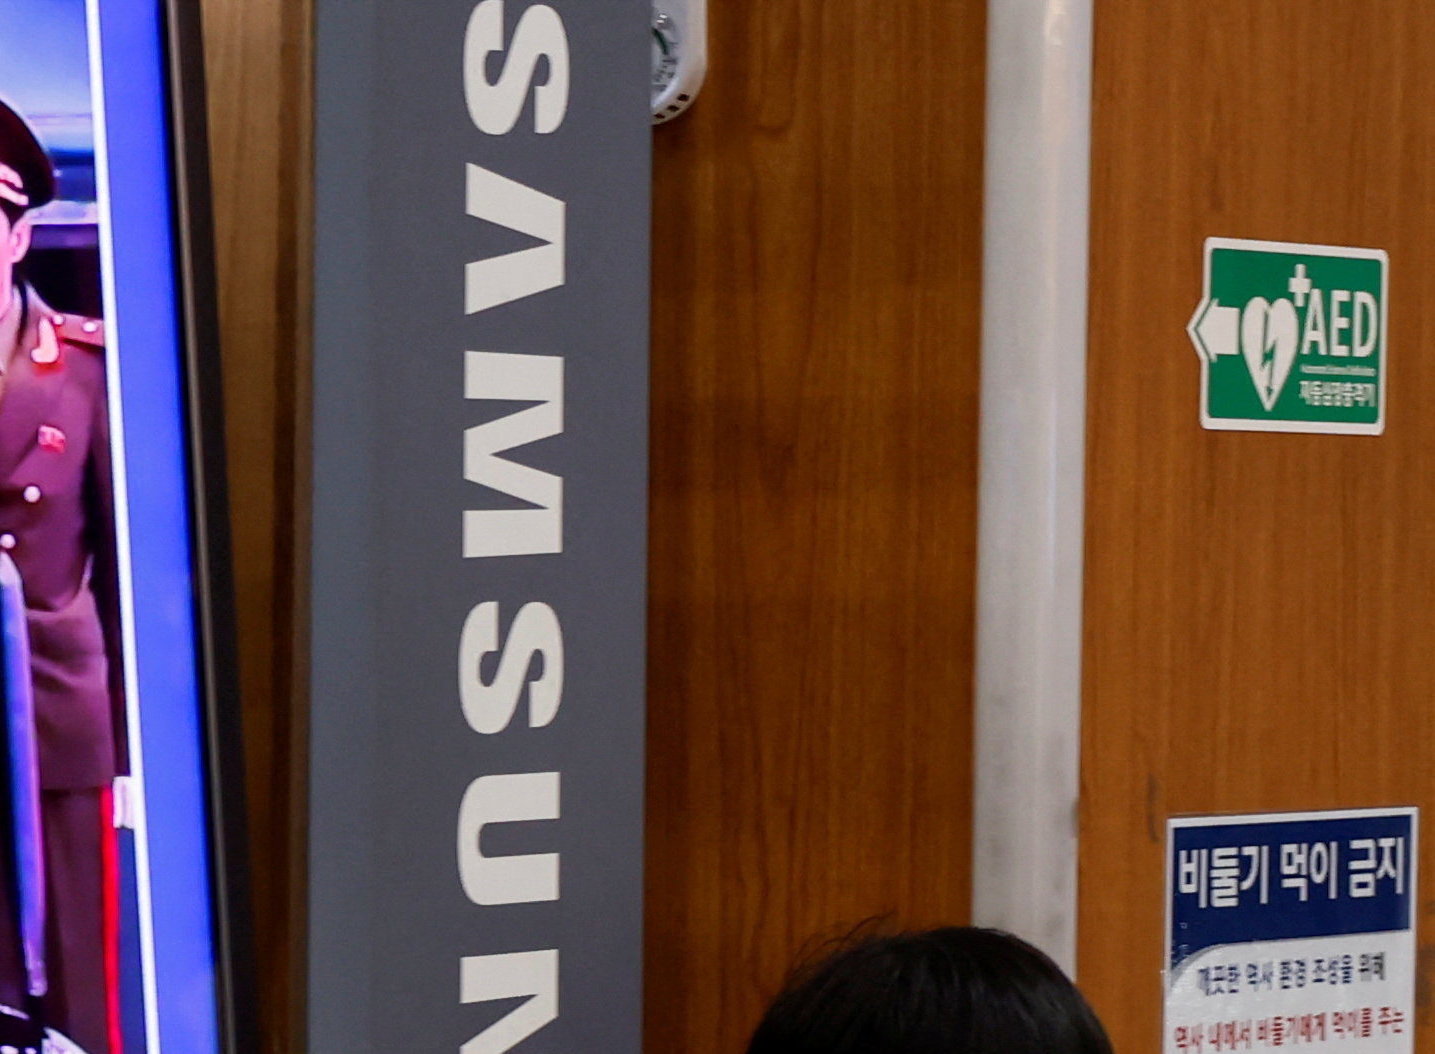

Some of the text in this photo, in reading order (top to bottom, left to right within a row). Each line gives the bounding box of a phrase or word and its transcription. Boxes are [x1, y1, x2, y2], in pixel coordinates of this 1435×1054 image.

[1301, 288, 1378, 357] AED
[1179, 837, 1404, 909] 비둘기 먹이 금지
[1358, 952, 1385, 982] 위해
[1256, 1012, 1327, 1046] 비둘기에게
[1333, 1007, 1373, 1039] 먹이를
[1377, 1006, 1405, 1035] 주는
